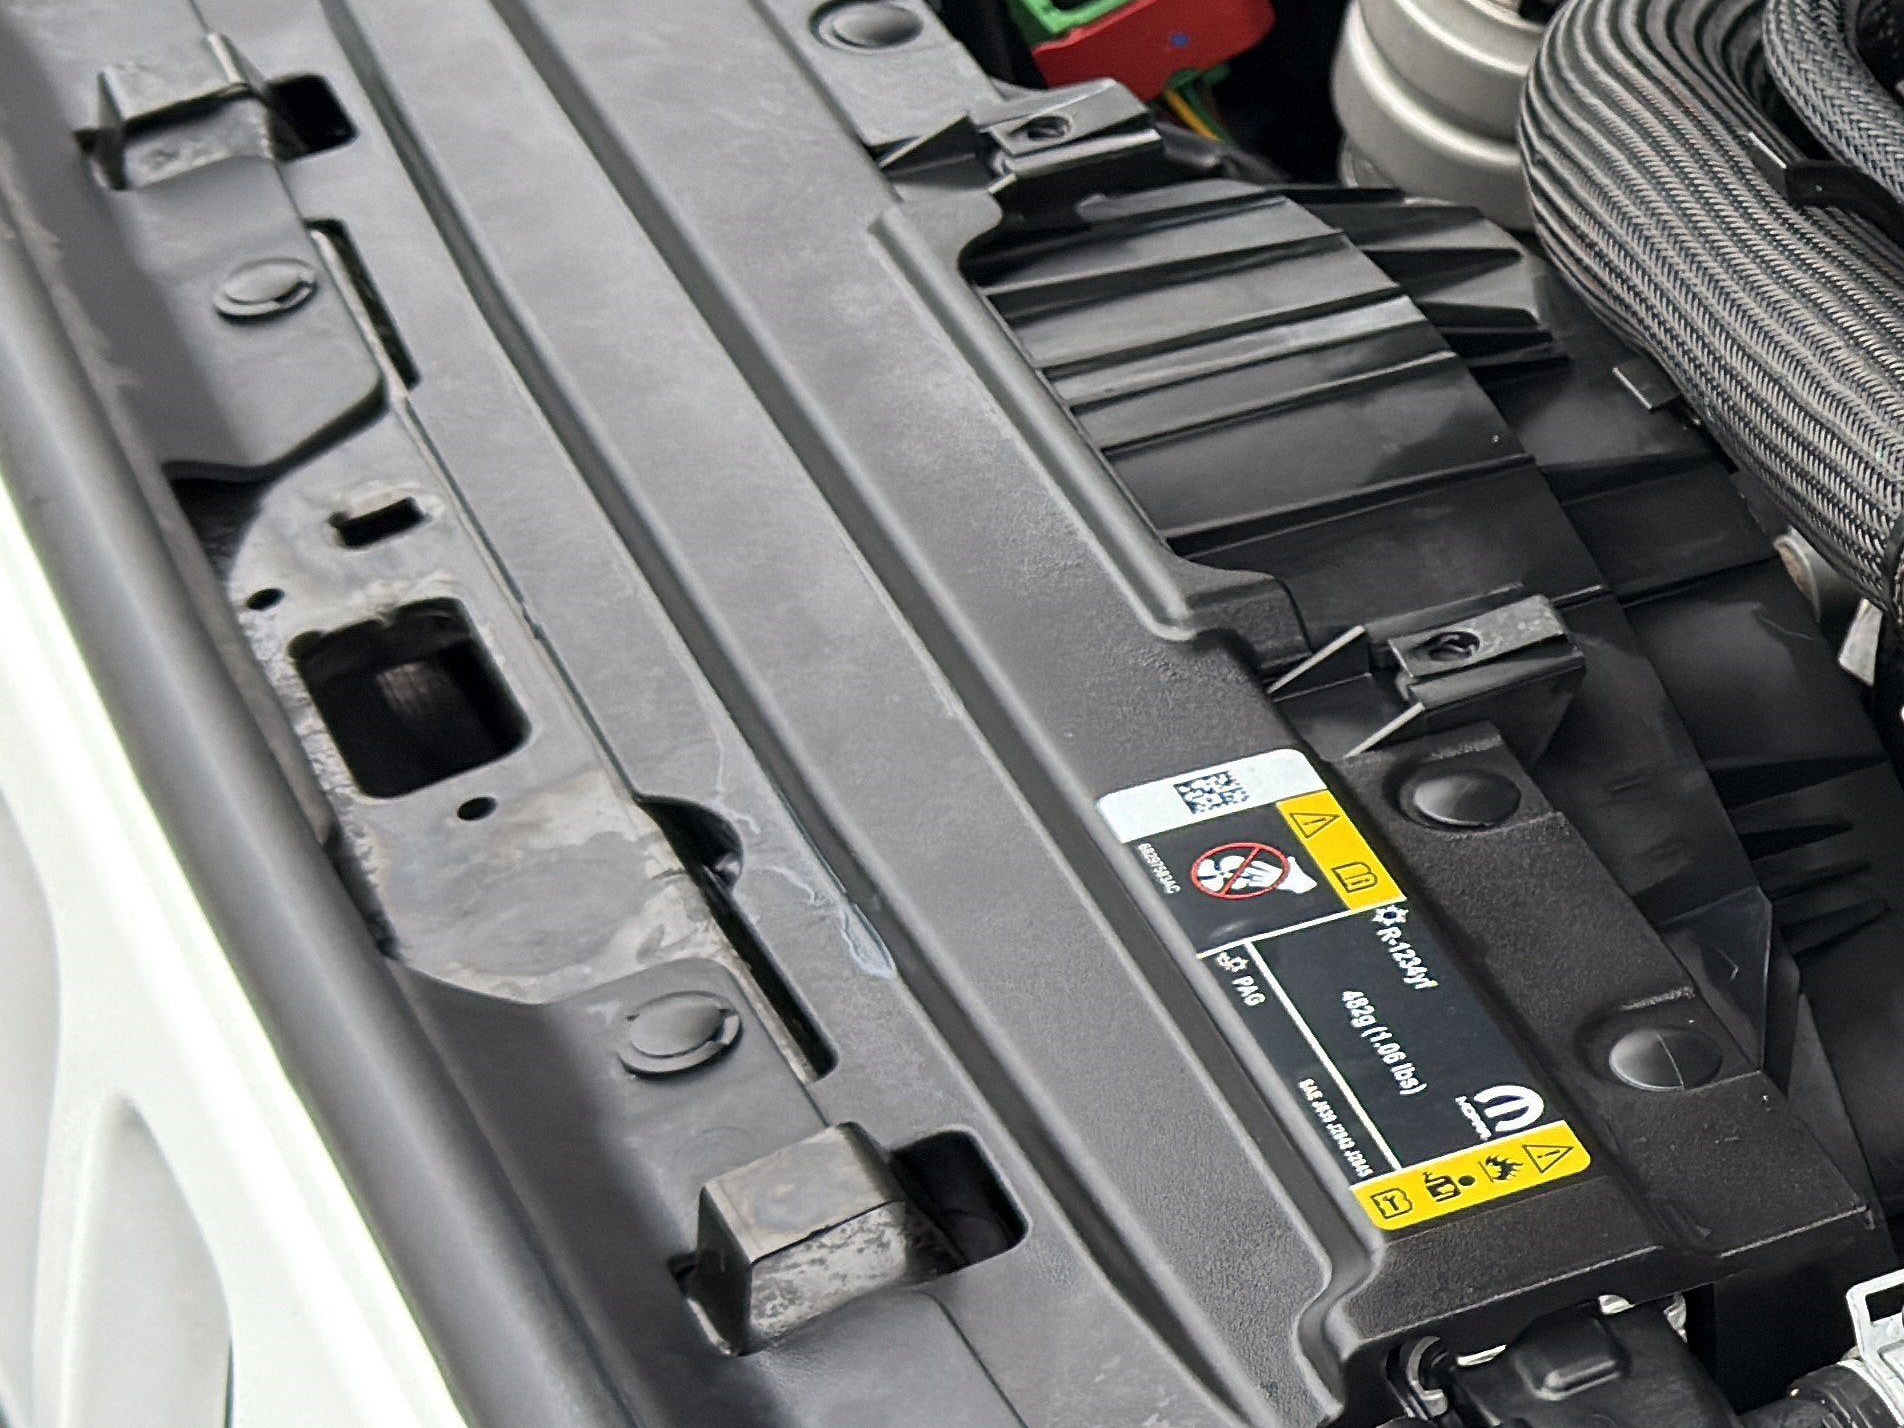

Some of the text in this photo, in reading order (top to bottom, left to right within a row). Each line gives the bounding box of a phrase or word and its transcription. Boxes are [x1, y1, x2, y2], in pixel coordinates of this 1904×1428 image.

[1376, 925, 1440, 990] R-1234yf
[1232, 975, 1266, 1006] PAG
[1342, 990, 1428, 1095] 482g (1.06 lbs)
